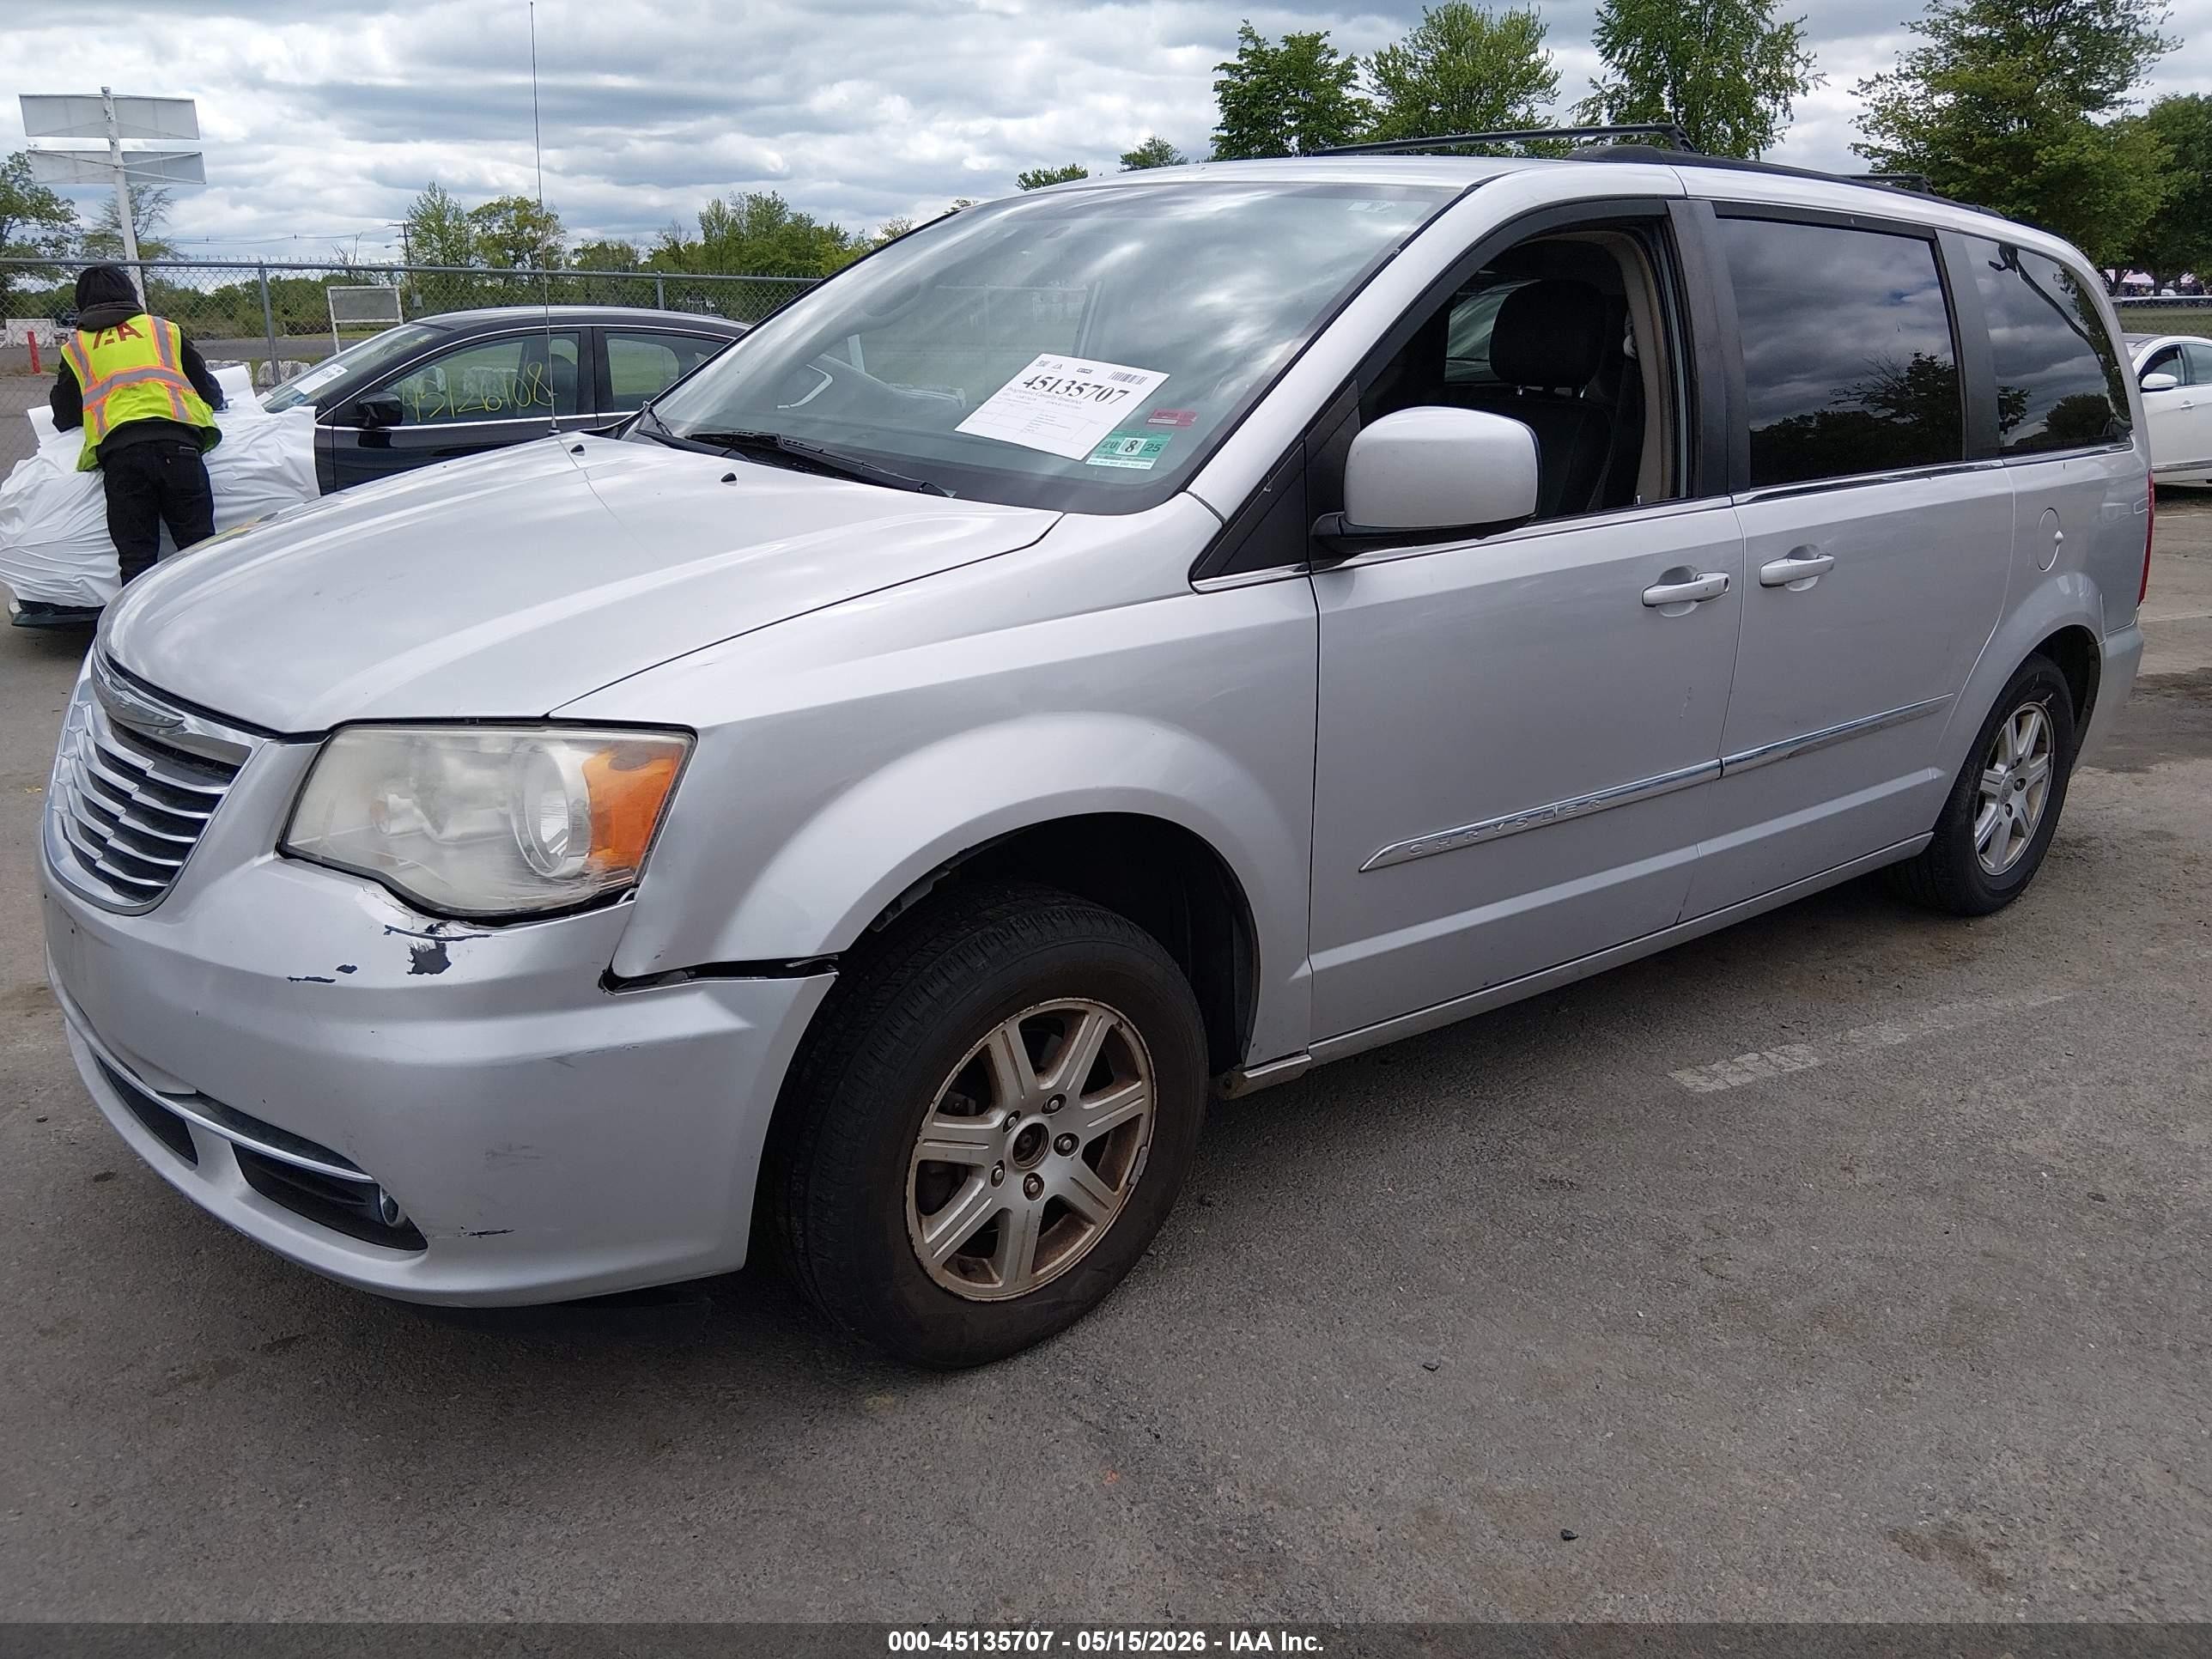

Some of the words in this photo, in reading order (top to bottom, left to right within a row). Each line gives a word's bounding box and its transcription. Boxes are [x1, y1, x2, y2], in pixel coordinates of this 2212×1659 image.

[1023, 374, 1132, 405] 45135707
[1124, 439, 1139, 453] 8
[1144, 443, 1163, 453] 25
[1408, 798, 1601, 857] CHRYSLER
